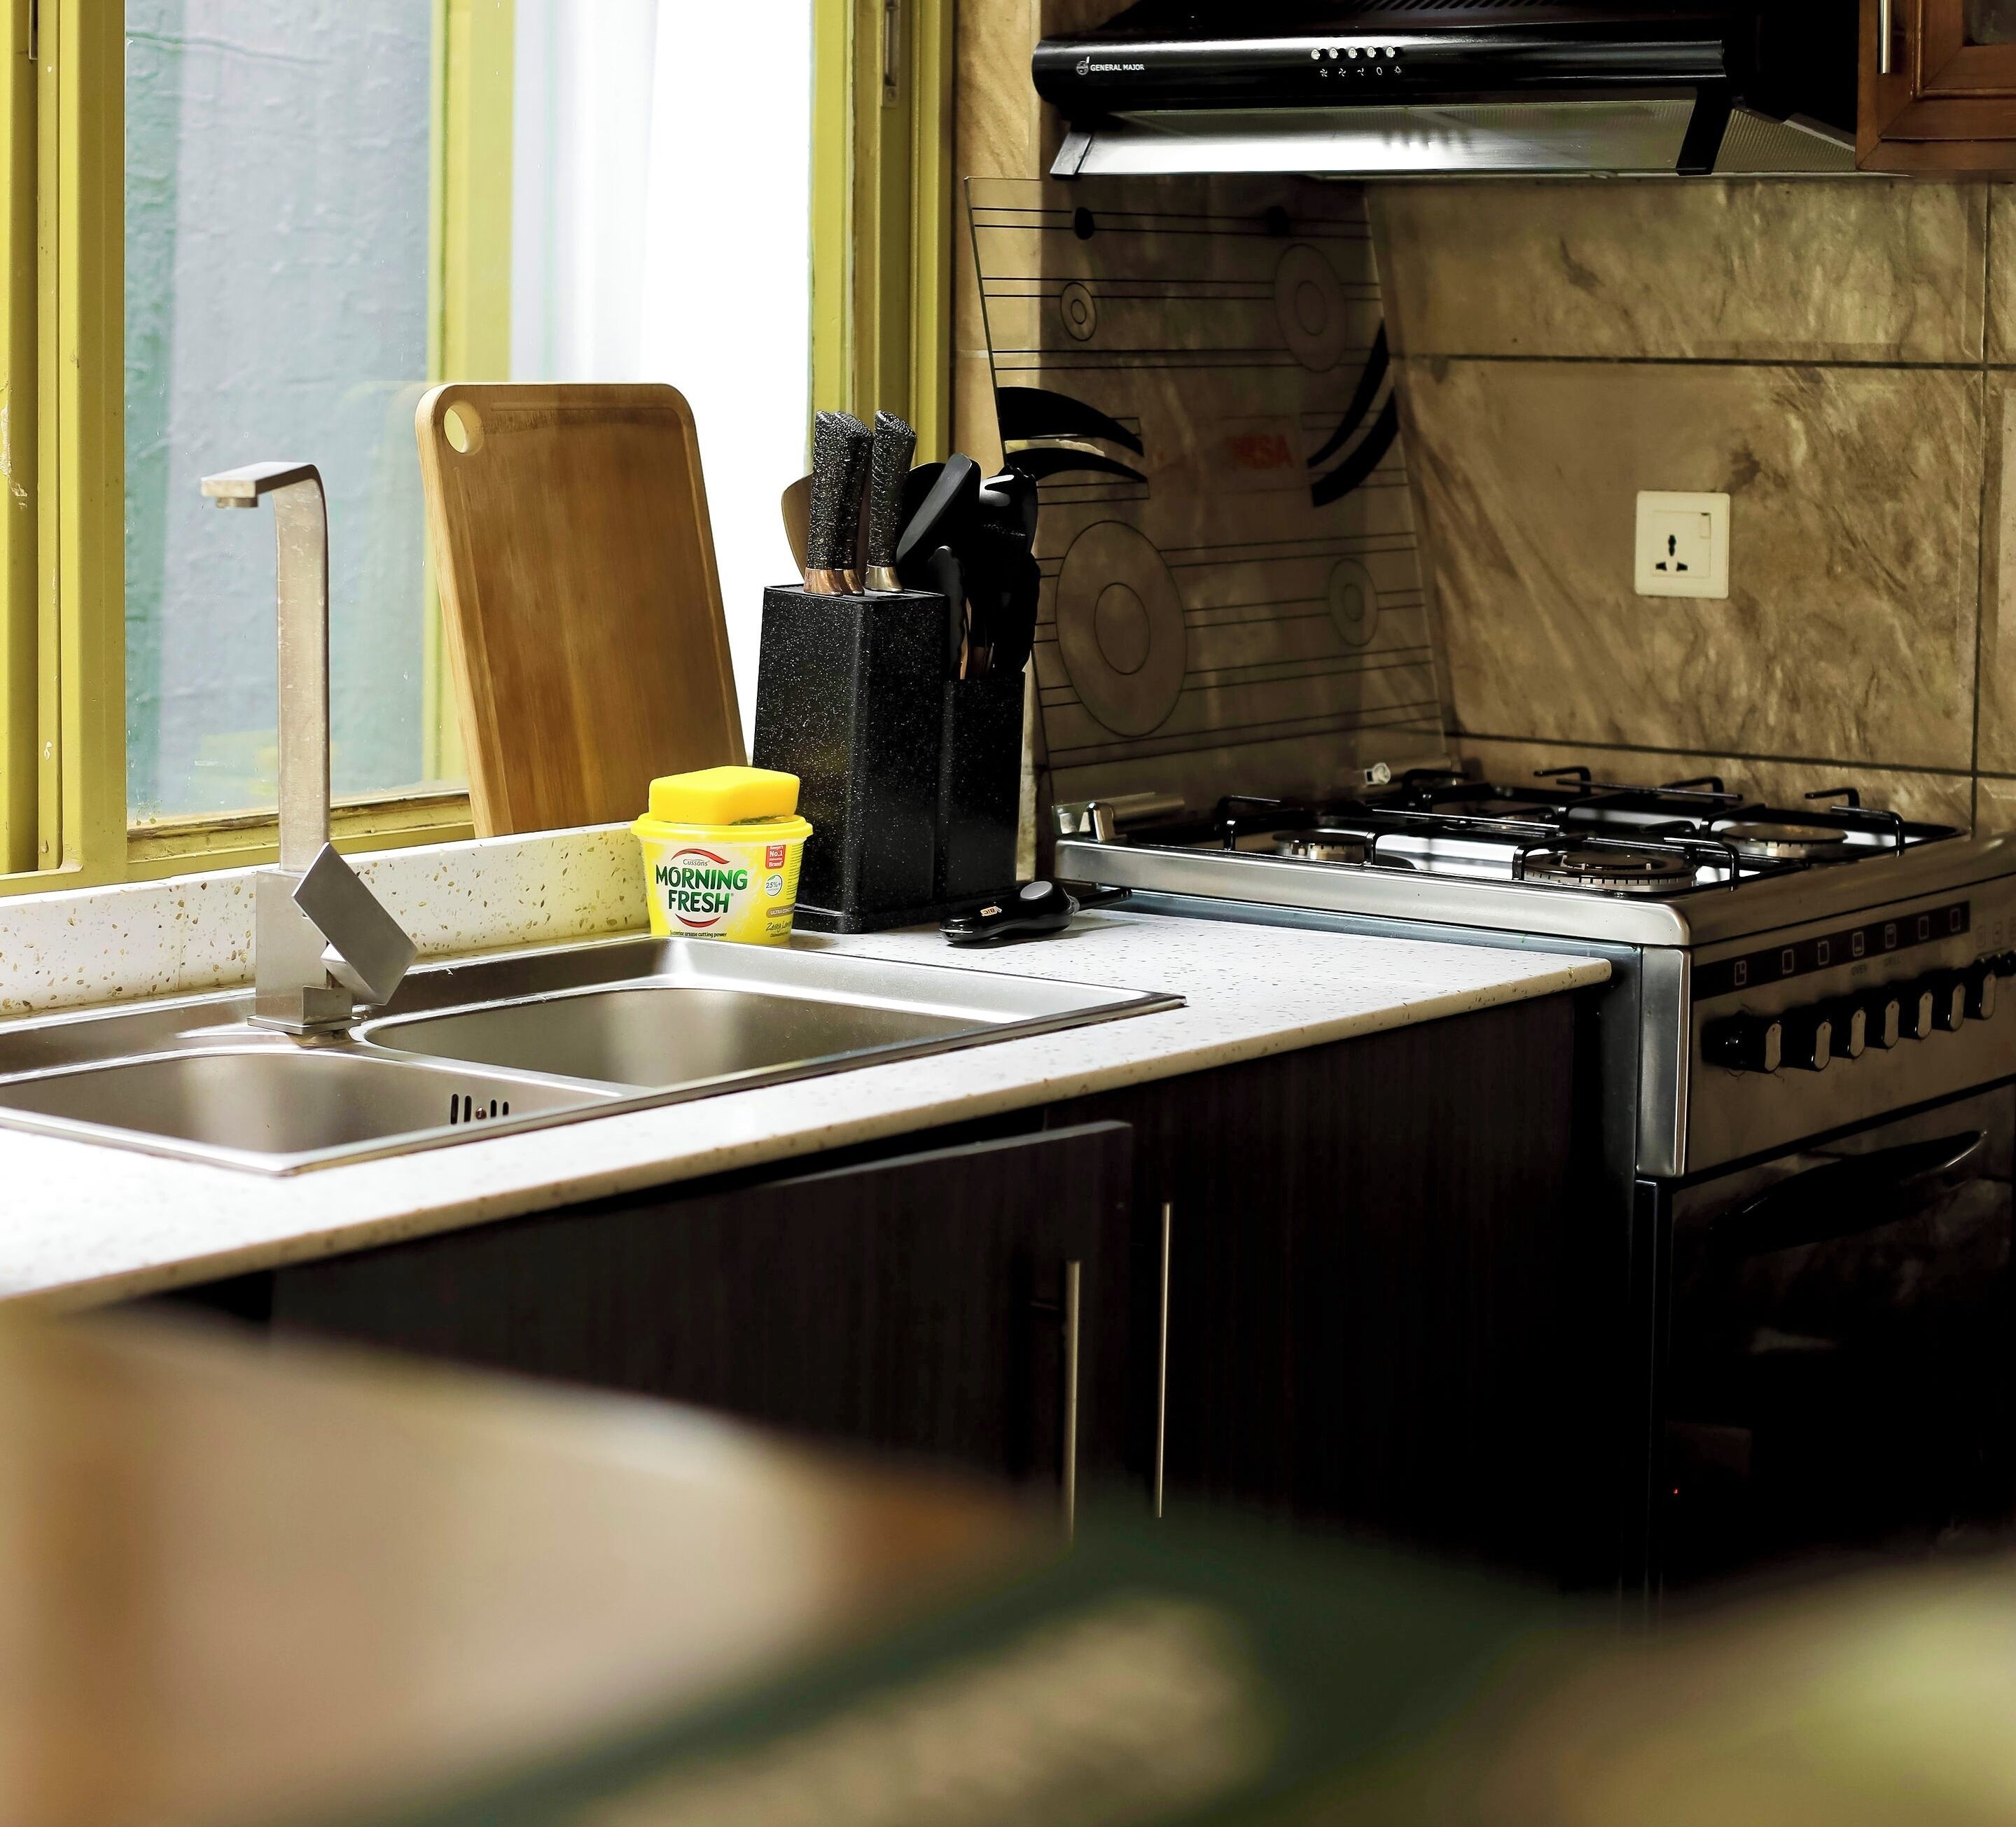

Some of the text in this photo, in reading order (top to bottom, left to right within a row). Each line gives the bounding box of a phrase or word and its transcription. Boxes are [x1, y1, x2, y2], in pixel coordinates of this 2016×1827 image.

[770, 849, 784, 858] No.1
[683, 859, 709, 867] Cussons
[655, 864, 748, 891] MORNING
[668, 889, 730, 913] FRESH
